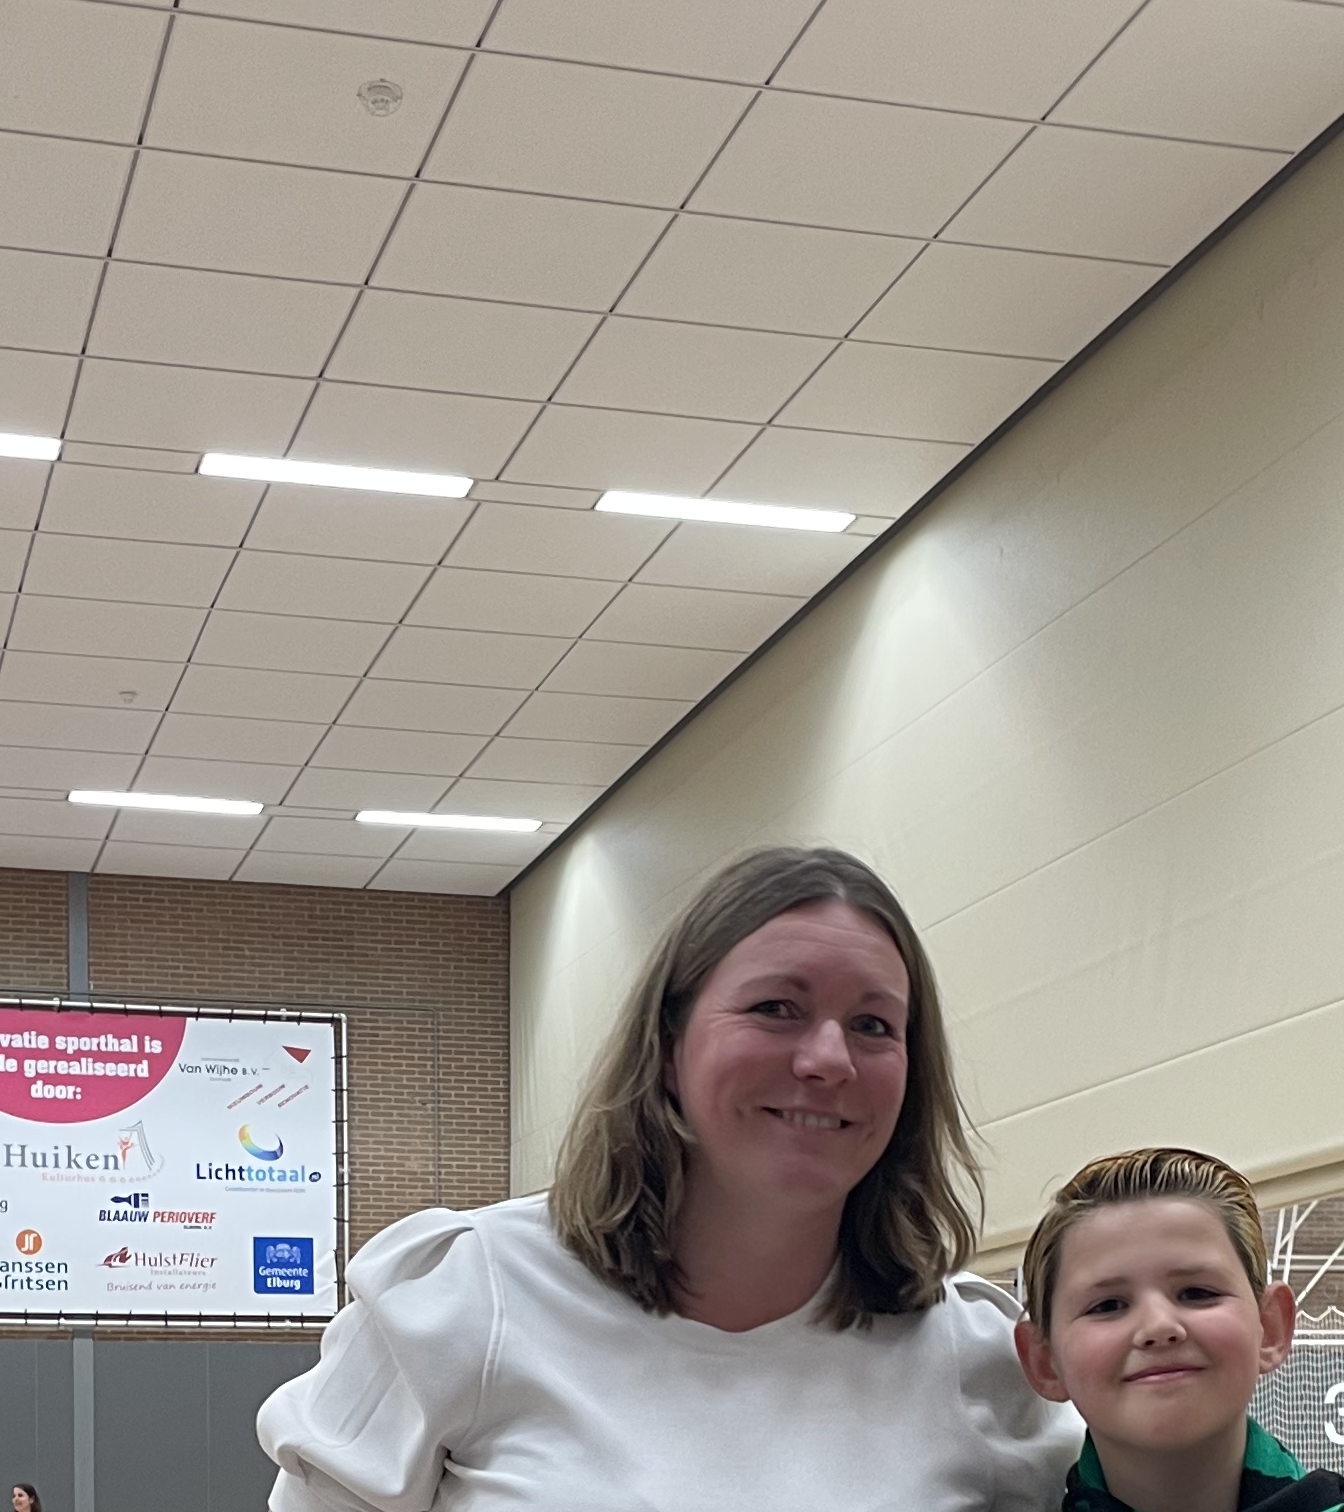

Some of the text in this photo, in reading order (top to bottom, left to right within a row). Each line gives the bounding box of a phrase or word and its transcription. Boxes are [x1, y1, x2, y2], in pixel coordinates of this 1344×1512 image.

[55, 1033, 138, 1054] sporthal
[144, 1036, 163, 1054] is
[23, 1057, 149, 1078] gerealiseerd
[179, 1063, 202, 1074] Van
[205, 1063, 238, 1076] Wijhe
[30, 1080, 82, 1100] door:
[3, 1144, 120, 1171] Huiken
[196, 1163, 306, 1183] Lichttotaal
[98, 1209, 217, 1224] BLAAUW PERIOVERF
[134, 1251, 218, 1269] HulstFlier
[258, 1265, 309, 1277] Gemeente
[4, 1275, 68, 1291] fritsen
[106, 1281, 153, 1292] Bruisend
[179, 1281, 217, 1293] energie
[266, 1277, 301, 1290] Elburg
